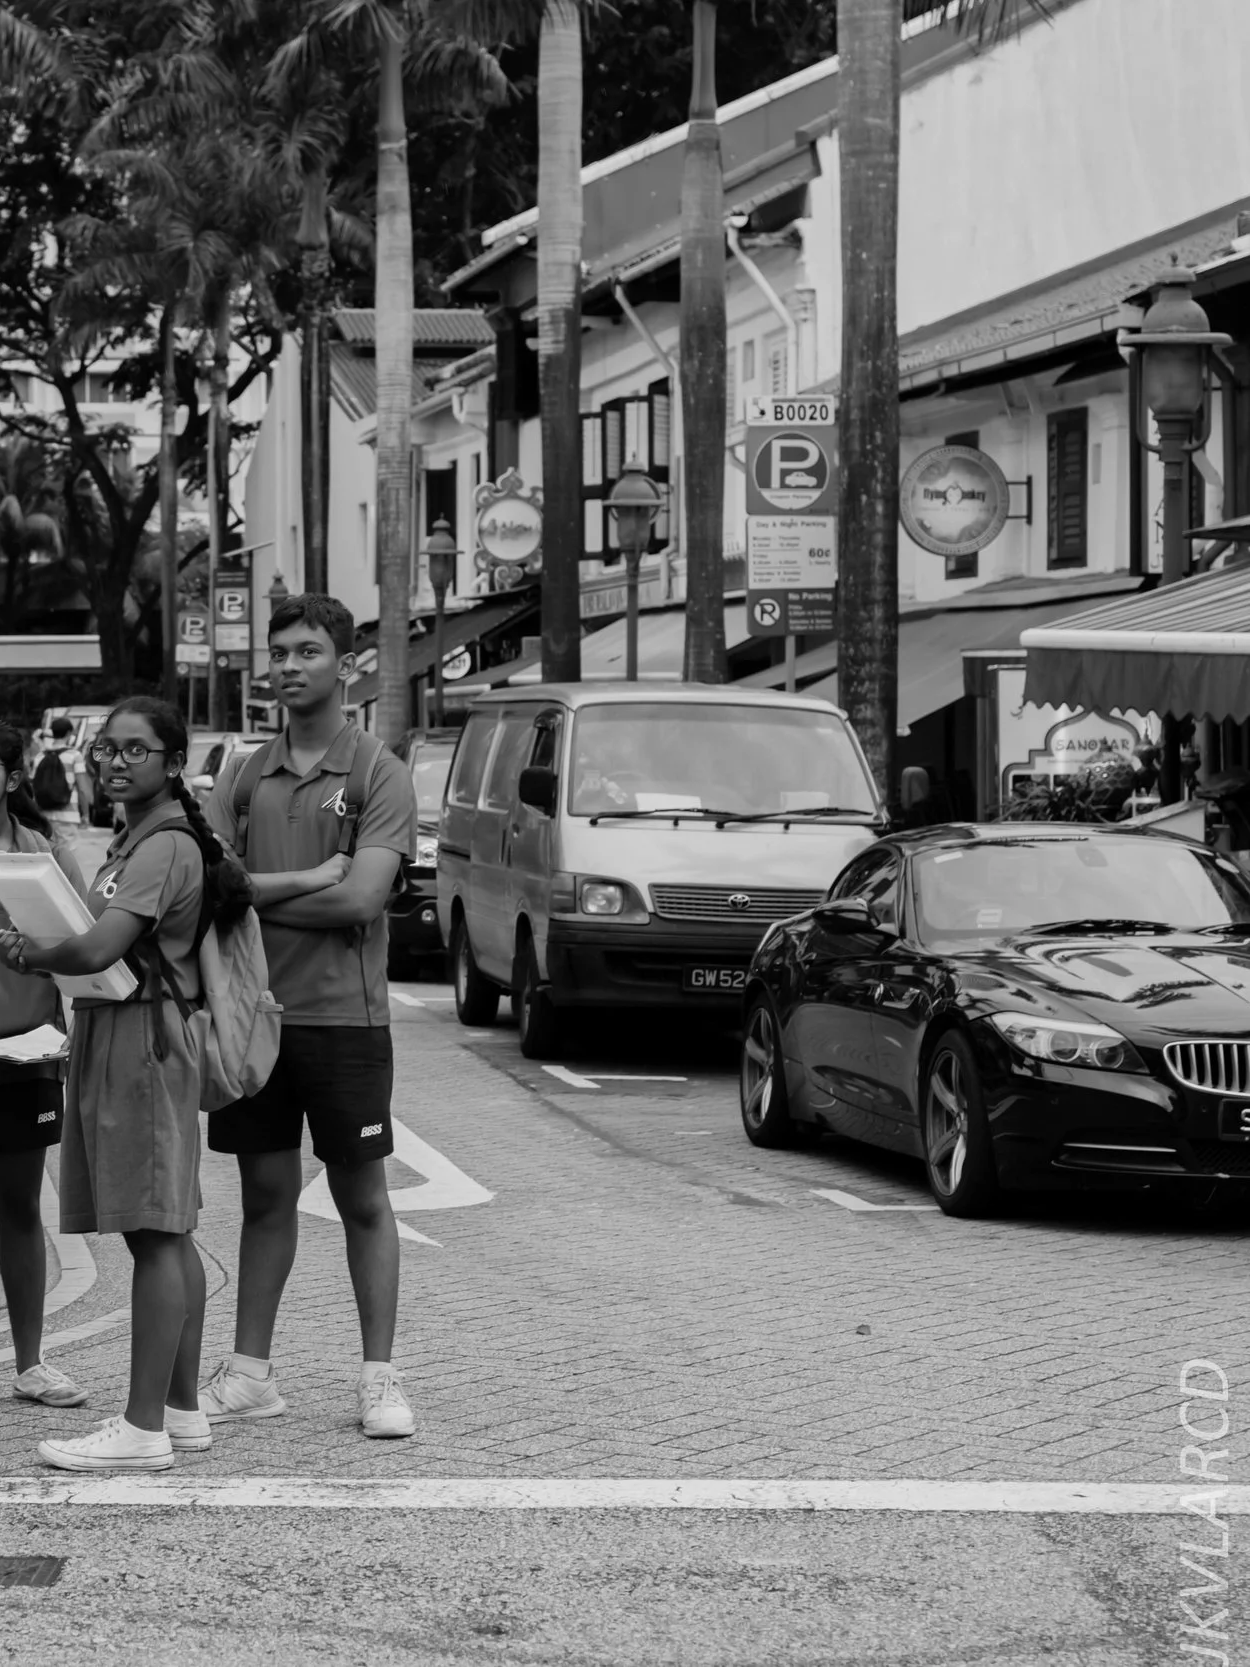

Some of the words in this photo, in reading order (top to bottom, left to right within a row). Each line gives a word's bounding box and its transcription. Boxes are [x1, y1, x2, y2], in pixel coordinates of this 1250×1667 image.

[774, 404, 829, 421] B0020
[771, 439, 820, 489] P
[788, 592, 800, 600] No
[802, 592, 833, 602] Parking
[1055, 738, 1131, 752] SANOAR
[37, 1110, 56, 1124] BBSS
[360, 1123, 383, 1138] BBSS
